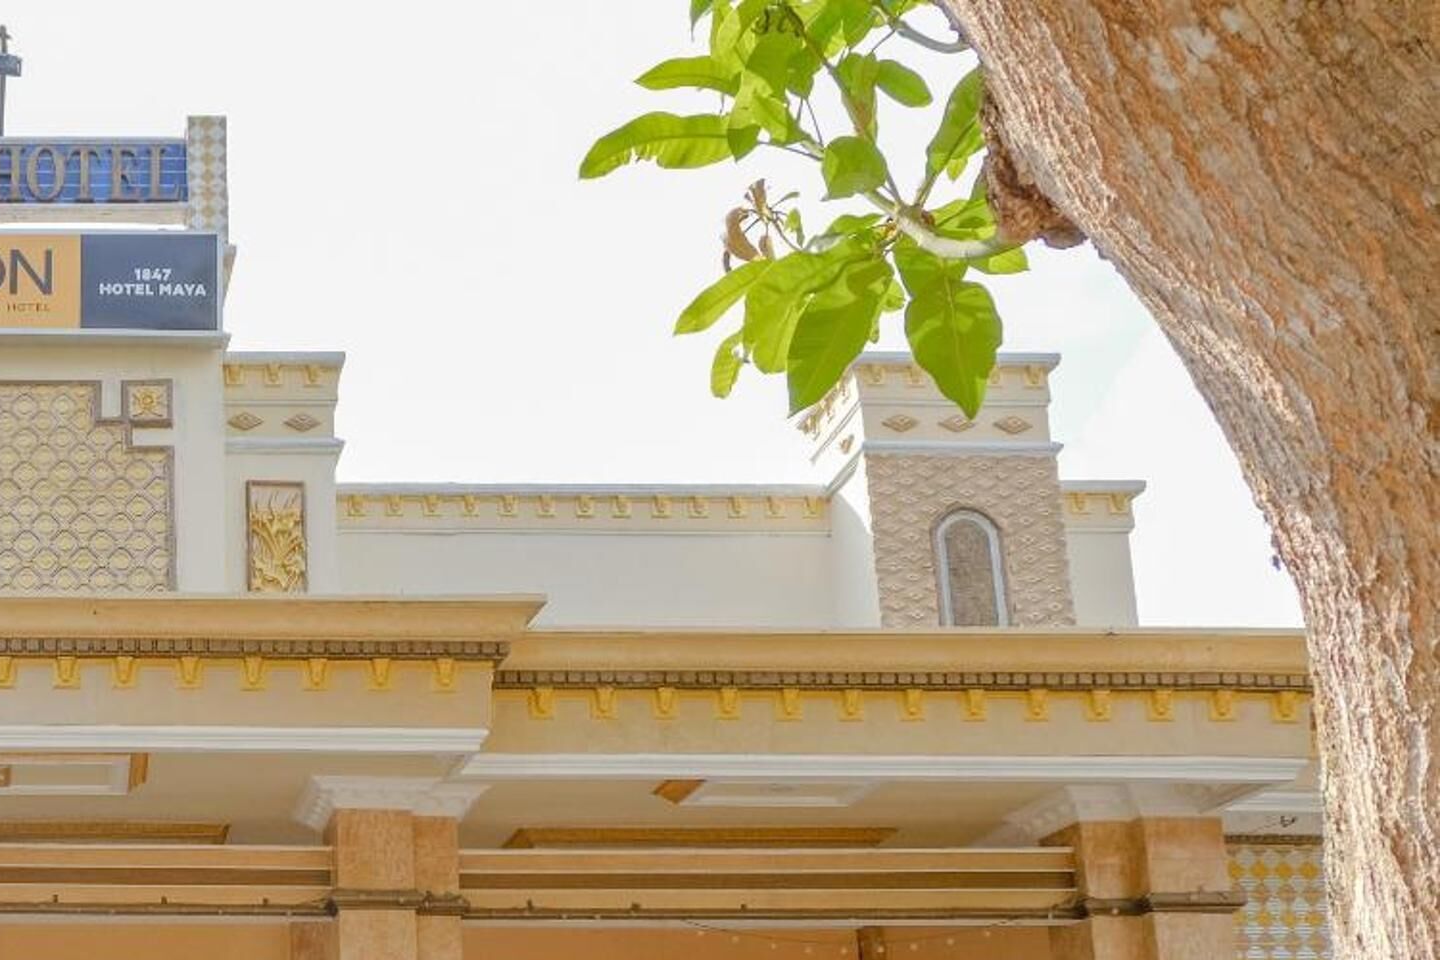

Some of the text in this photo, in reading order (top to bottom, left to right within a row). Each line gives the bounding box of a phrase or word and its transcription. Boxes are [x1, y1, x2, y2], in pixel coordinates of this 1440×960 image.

[134, 267, 172, 281] 1847
[99, 283, 206, 297] HOTEL MAYA
[7, 302, 51, 313] HOTEL
